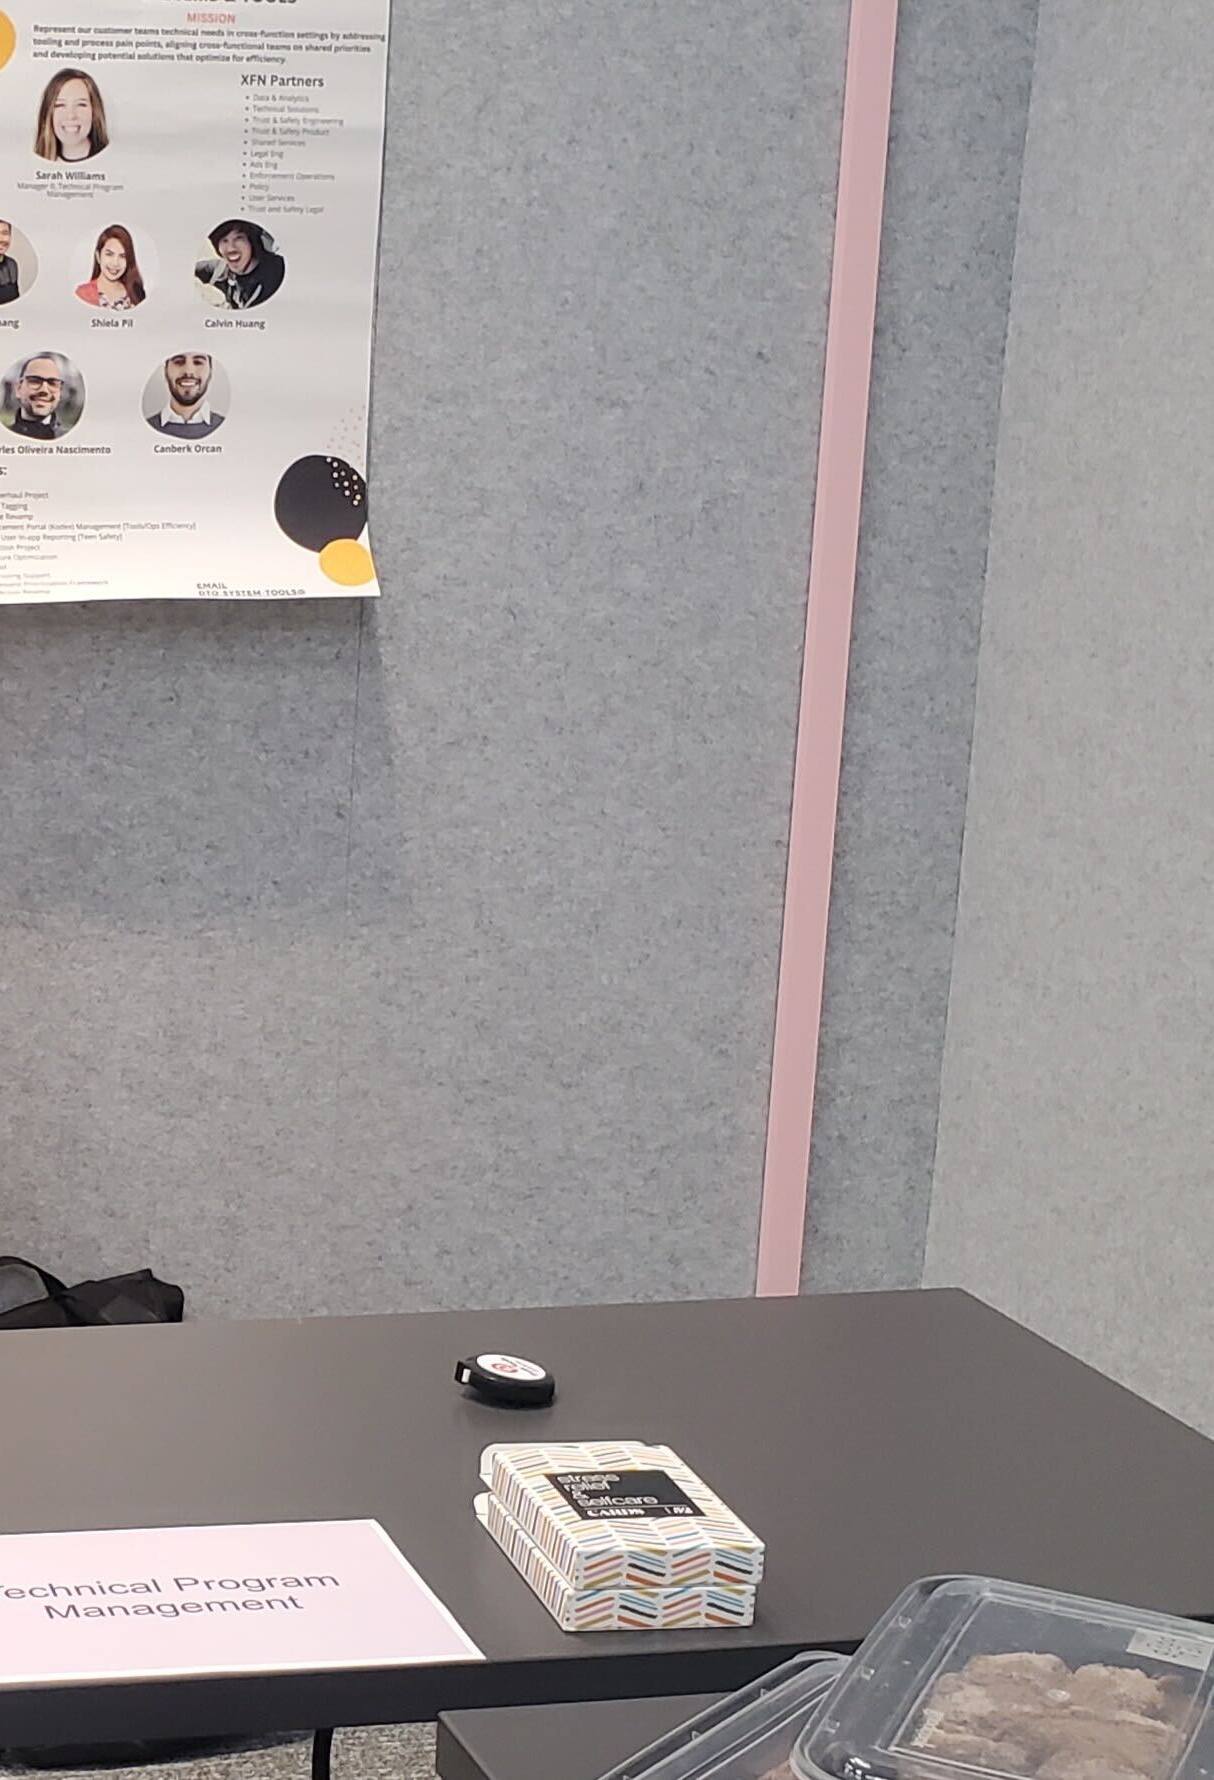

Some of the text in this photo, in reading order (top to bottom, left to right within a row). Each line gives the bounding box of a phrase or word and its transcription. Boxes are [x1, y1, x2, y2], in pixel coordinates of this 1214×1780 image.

[187, 13, 236, 24] MISSION
[33, 25, 76, 34] Represent
[93, 27, 132, 35] customer
[134, 28, 159, 36] teams
[161, 28, 198, 36] technical
[200, 29, 225, 37] needs
[236, 30, 295, 39] cross-function
[296, 32, 329, 41] settings
[330, 32, 340, 41] by
[342, 33, 386, 42] addressing
[33, 38, 62, 47] tooling
[82, 40, 113, 48] process
[115, 40, 133, 48] pain
[135, 41, 163, 49] points,
[165, 41, 197, 50] aligning
[198, 42, 264, 50] cross-functional
[266, 43, 291, 51] teams
[305, 44, 333, 52] shared
[334, 45, 371, 53] priorities
[50, 51, 96, 61] developing
[98, 53, 136, 62] potential
[137, 53, 175, 61] solutions
[176, 53, 194, 61] that
[195, 54, 230, 63] optimize
[232, 54, 244, 62] for
[241, 74, 324, 87] XFN Partners
[35, 170, 106, 180] Sarah Williams
[91, 318, 119, 328] Shiela
[204, 319, 266, 330] Calvin Huang
[17, 445, 54, 454] Oliveira
[55, 445, 111, 454] Nascimento
[153, 444, 222, 454] Canberk Orcan
[197, 582, 228, 590] EMAIL
[556, 1473, 620, 1484] stress
[563, 1480, 611, 1492] relief
[173, 1573, 340, 1594] Program
[43, 1595, 305, 1619] Management
